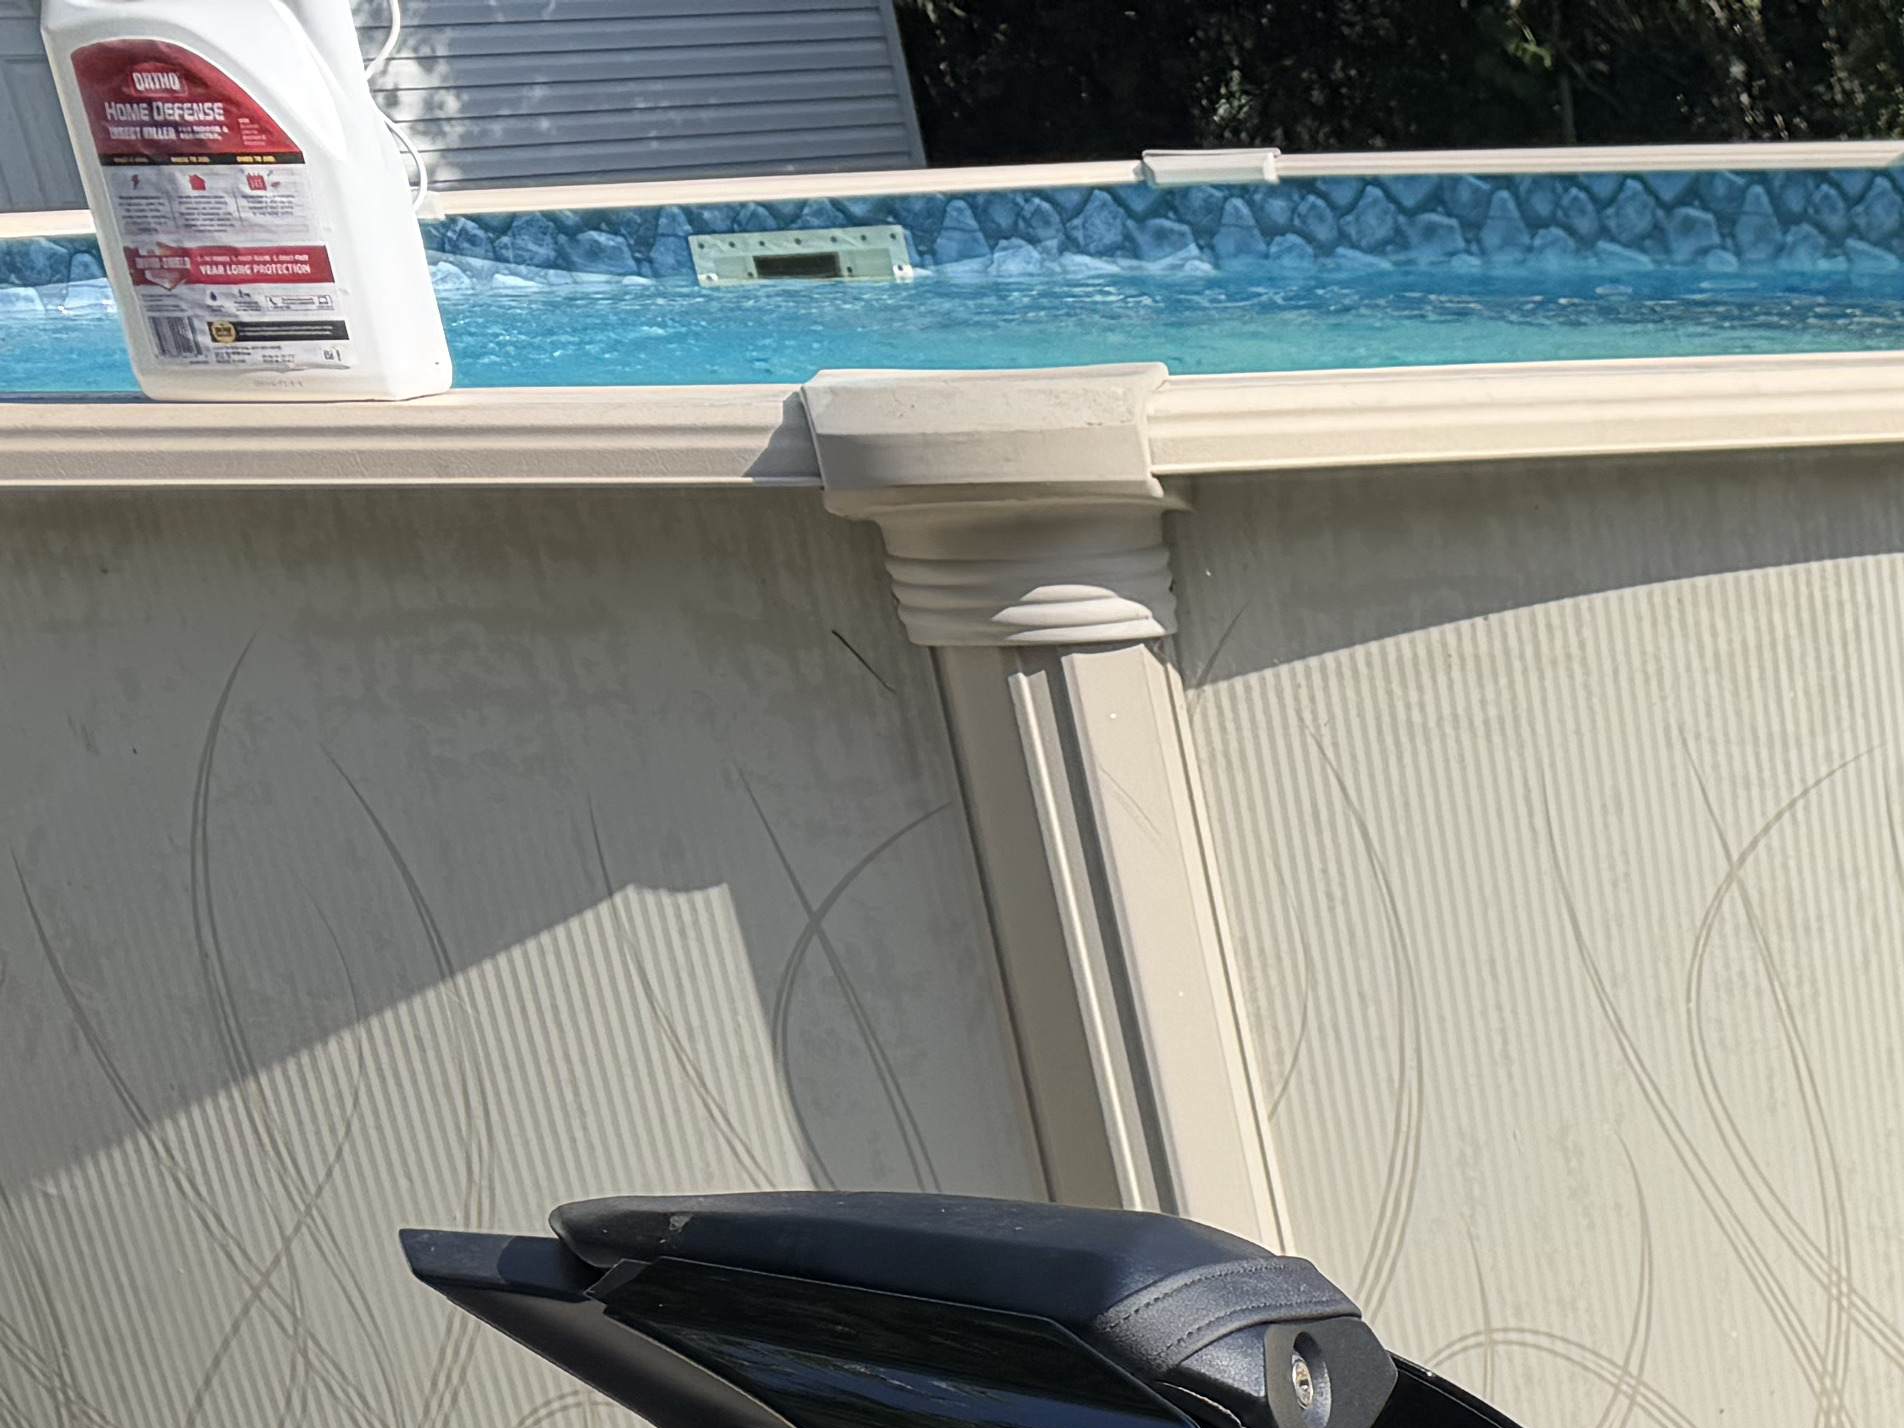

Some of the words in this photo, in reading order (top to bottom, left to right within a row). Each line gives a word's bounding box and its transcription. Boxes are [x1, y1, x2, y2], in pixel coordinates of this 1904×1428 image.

[132, 72, 181, 91] ORTHO
[152, 102, 225, 121] DEFENSE
[253, 263, 311, 275] PROTECTION
